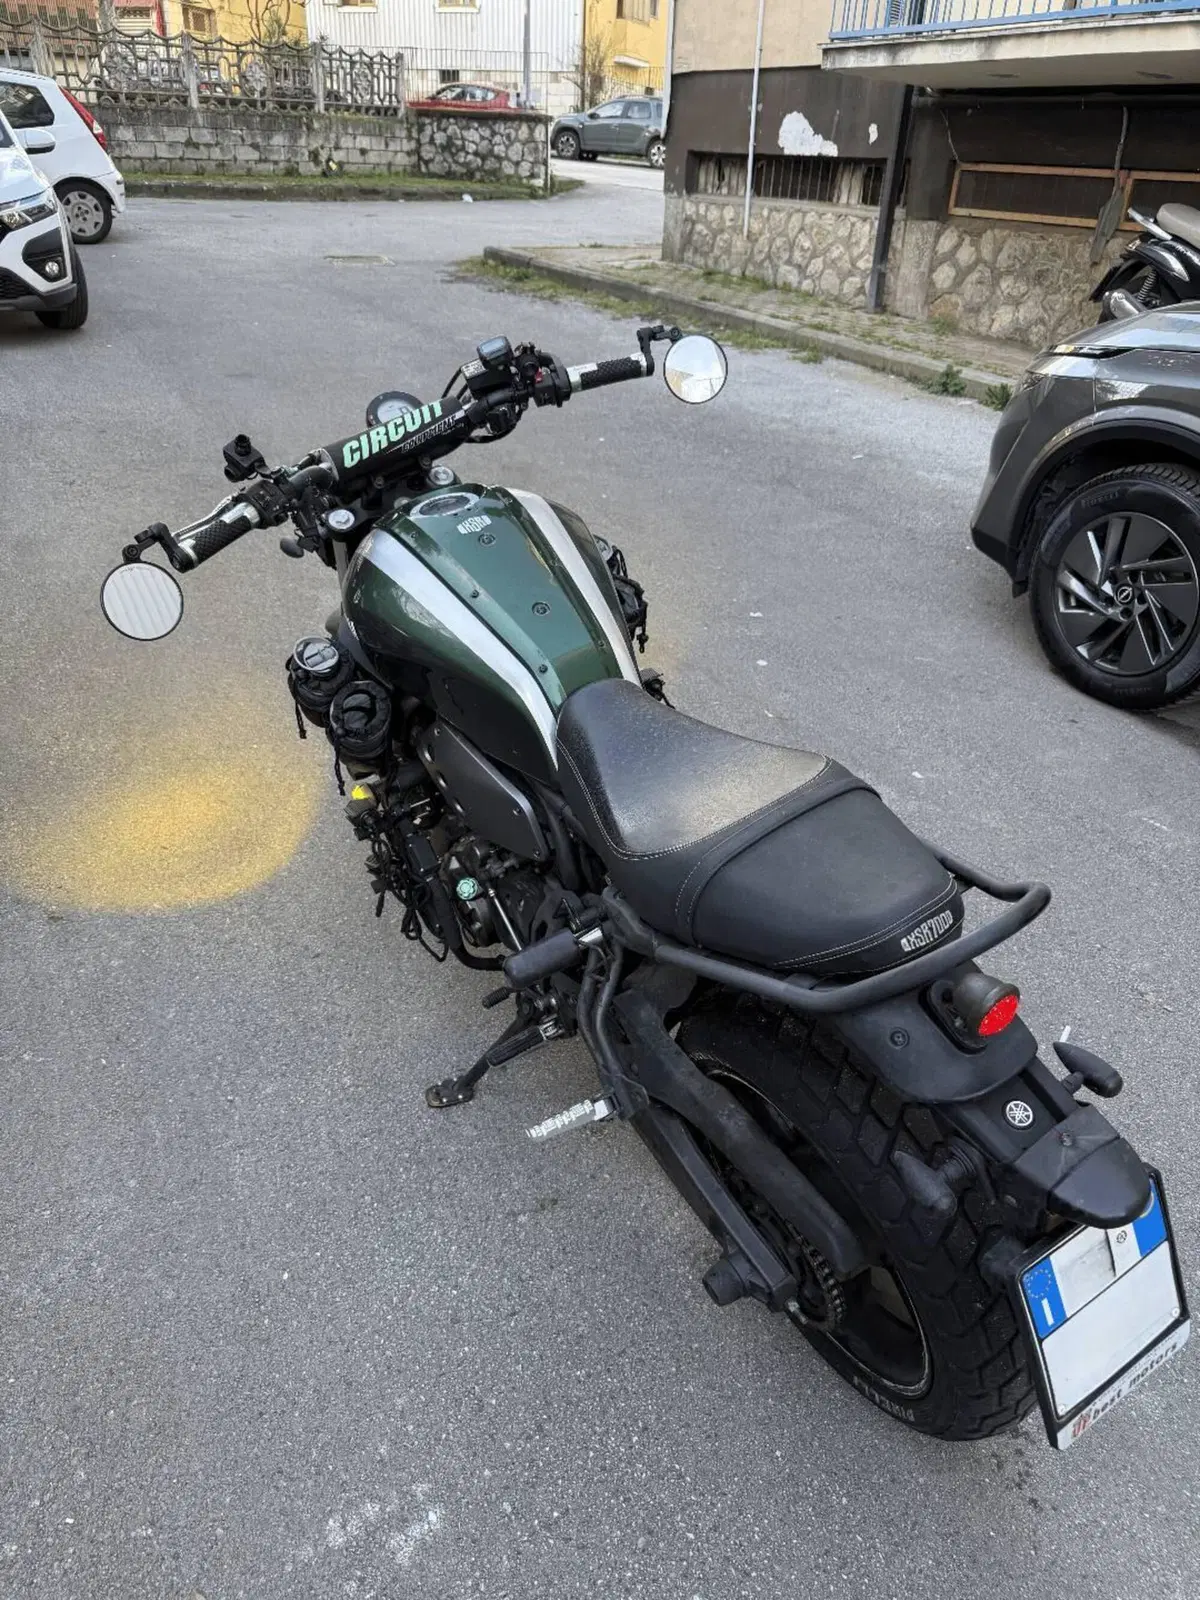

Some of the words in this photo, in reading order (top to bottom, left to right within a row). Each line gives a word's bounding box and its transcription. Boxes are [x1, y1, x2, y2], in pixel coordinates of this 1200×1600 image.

[342, 400, 443, 468] CIRCUIT
[1093, 1388, 1122, 1421] best
[1129, 1342, 1177, 1388] motors
